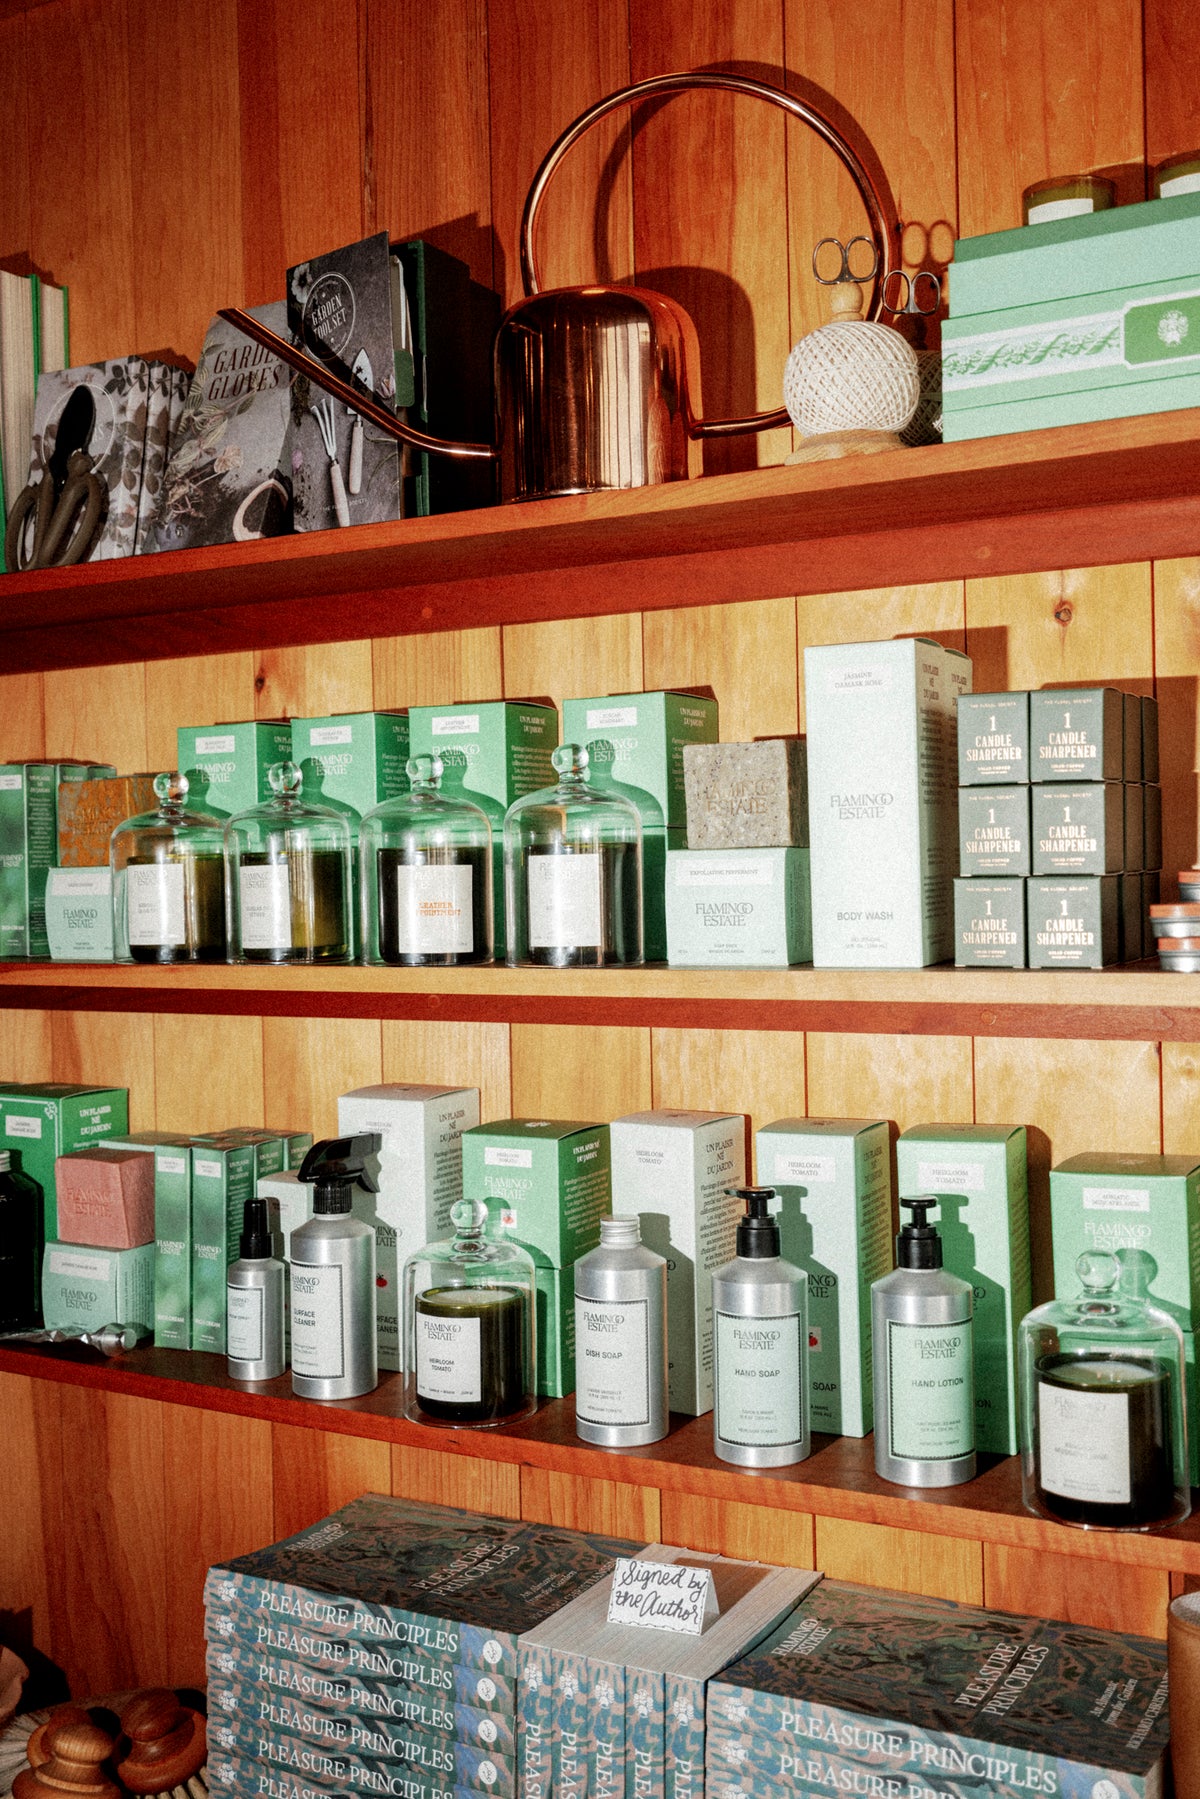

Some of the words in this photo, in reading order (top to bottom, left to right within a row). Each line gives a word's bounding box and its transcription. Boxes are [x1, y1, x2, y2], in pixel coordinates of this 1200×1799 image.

[311, 292, 342, 326] GARDEN
[313, 320, 333, 340] TOOL
[331, 307, 347, 330] SET
[213, 343, 279, 375] GARDE
[208, 364, 283, 401] GLOVES
[844, 671, 873, 680] JASMINE
[834, 681, 863, 689] DAMASK
[989, 715, 997, 732] 1
[1063, 712, 1071, 729] 1
[585, 738, 639, 752] FLAMINGO
[975, 734, 1012, 748] CANDLE
[1048, 731, 1087, 745] CANDLE
[432, 744, 480, 756] FLAMINGO
[593, 750, 631, 762] ESTATE
[966, 747, 1022, 762] SHARPENER
[1039, 744, 1097, 759] SHARPENER
[311, 753, 353, 766] FLAMINGO
[195, 762, 236, 774] FLAMINGO
[316, 764, 347, 776] ESTATE
[201, 772, 231, 783] ESTATE
[830, 792, 894, 808] FLAMINGO
[839, 806, 885, 820] ESTATE
[988, 808, 995, 824] 1
[1063, 806, 1071, 822] 1
[974, 826, 1011, 840] CANDLE
[1048, 824, 1087, 838] CANDLE
[965, 839, 1021, 853] SHARPENER
[1039, 838, 1097, 852] SHARPENER
[62, 909, 98, 919] FLAMINGO
[695, 902, 754, 915] FLAMINGO
[985, 899, 992, 915] 1
[1060, 899, 1068, 916] 1
[703, 914, 746, 927] ESTATE
[837, 911, 862, 921] BODY
[865, 911, 894, 921] WASH
[68, 919, 94, 929] ESTATE
[971, 918, 1008, 932] CANDLE
[1045, 918, 1085, 932] CANDLE
[962, 932, 1017, 945] SHARPENER
[1036, 932, 1094, 946] SHARPENER
[79, 1109, 89, 1117] UN
[89, 1105, 112, 1115] PLAISIR
[80, 1127, 91, 1135] DU
[91, 1122, 112, 1135] JARDIN
[447, 1130, 465, 1142] JARDI
[706, 1144, 715, 1153] UN
[714, 1139, 734, 1151] PLAISIR
[636, 1150, 664, 1158] HEIRLOOM
[638, 1157, 662, 1165] TOMATO
[706, 1166, 716, 1175] DU
[715, 1160, 735, 1175] JARDIN
[787, 1161, 822, 1169] HEIRLOOM
[932, 1168, 969, 1176] HEIRLOOM
[791, 1169, 819, 1177] TOMATO
[484, 1176, 533, 1190] FLAMINGO
[491, 1188, 526, 1200] ESTATE
[372, 1225, 403, 1238] MINGO
[1083, 1222, 1152, 1238] FLAMINGO
[156, 1239, 186, 1249] FLAMINGO
[376, 1236, 397, 1248] TATE
[1093, 1235, 1143, 1249] ESTATE
[60, 1287, 97, 1302] FLAMINGO
[66, 1299, 93, 1311] ESTATE
[293, 1308, 316, 1318] SURFACE
[376, 1315, 398, 1325] RFACE
[583, 1311, 625, 1324] FLAMINGO
[293, 1318, 316, 1327] CLEANER
[377, 1325, 399, 1334] EANER
[423, 1320, 462, 1333] FLAMINGO
[587, 1322, 618, 1333] ESTATE
[427, 1331, 457, 1341] ESTATE
[733, 1329, 781, 1341] FLAMINGO
[739, 1340, 775, 1350] ESTATE
[914, 1336, 962, 1350] FLAMINGO
[585, 1348, 600, 1358] DISH
[601, 1351, 623, 1359] SOAP
[920, 1347, 957, 1360] ESTATE
[429, 1358, 455, 1366] HEIRLOOM
[431, 1364, 452, 1372] TOMATO
[734, 1369, 756, 1377] HAND
[758, 1369, 781, 1378] SOAP
[812, 1382, 837, 1392] SOAP
[911, 1379, 935, 1387] HAND
[937, 1376, 964, 1387] LOTION
[411, 1542, 497, 1590] PLEASURE
[428, 1544, 520, 1597] PRINCIPLES
[617, 1560, 687, 1590] Signed
[687, 1572, 707, 1603] by
[615, 1590, 644, 1609] the
[639, 1590, 699, 1625] Author
[259, 1590, 349, 1628] PLEASURE
[353, 1612, 458, 1653] PRINCIPLES
[792, 1625, 833, 1656] ESTATE
[257, 1625, 345, 1663] PLEASURE
[349, 1648, 453, 1690] PRINCIPLES
[953, 1642, 1020, 1709] PLEASURE
[981, 1644, 1050, 1717] PRINCIPLES
[1116, 1678, 1138, 1701] Garden
[258, 1664, 346, 1702] PLEASURE
[350, 1687, 454, 1731] PRINCIPLES
[260, 1702, 347, 1742] PLEASURE
[351, 1727, 454, 1772] PRINCIPLES
[1125, 1717, 1155, 1750] RICHARD
[258, 1740, 346, 1779] PLEASURE
[780, 1710, 904, 1759] PLEASURE
[909, 1740, 1058, 1795] PRINCIPLES
[596, 1740, 613, 1799] PLEA
[779, 1754, 902, 1799] PLEASURE
